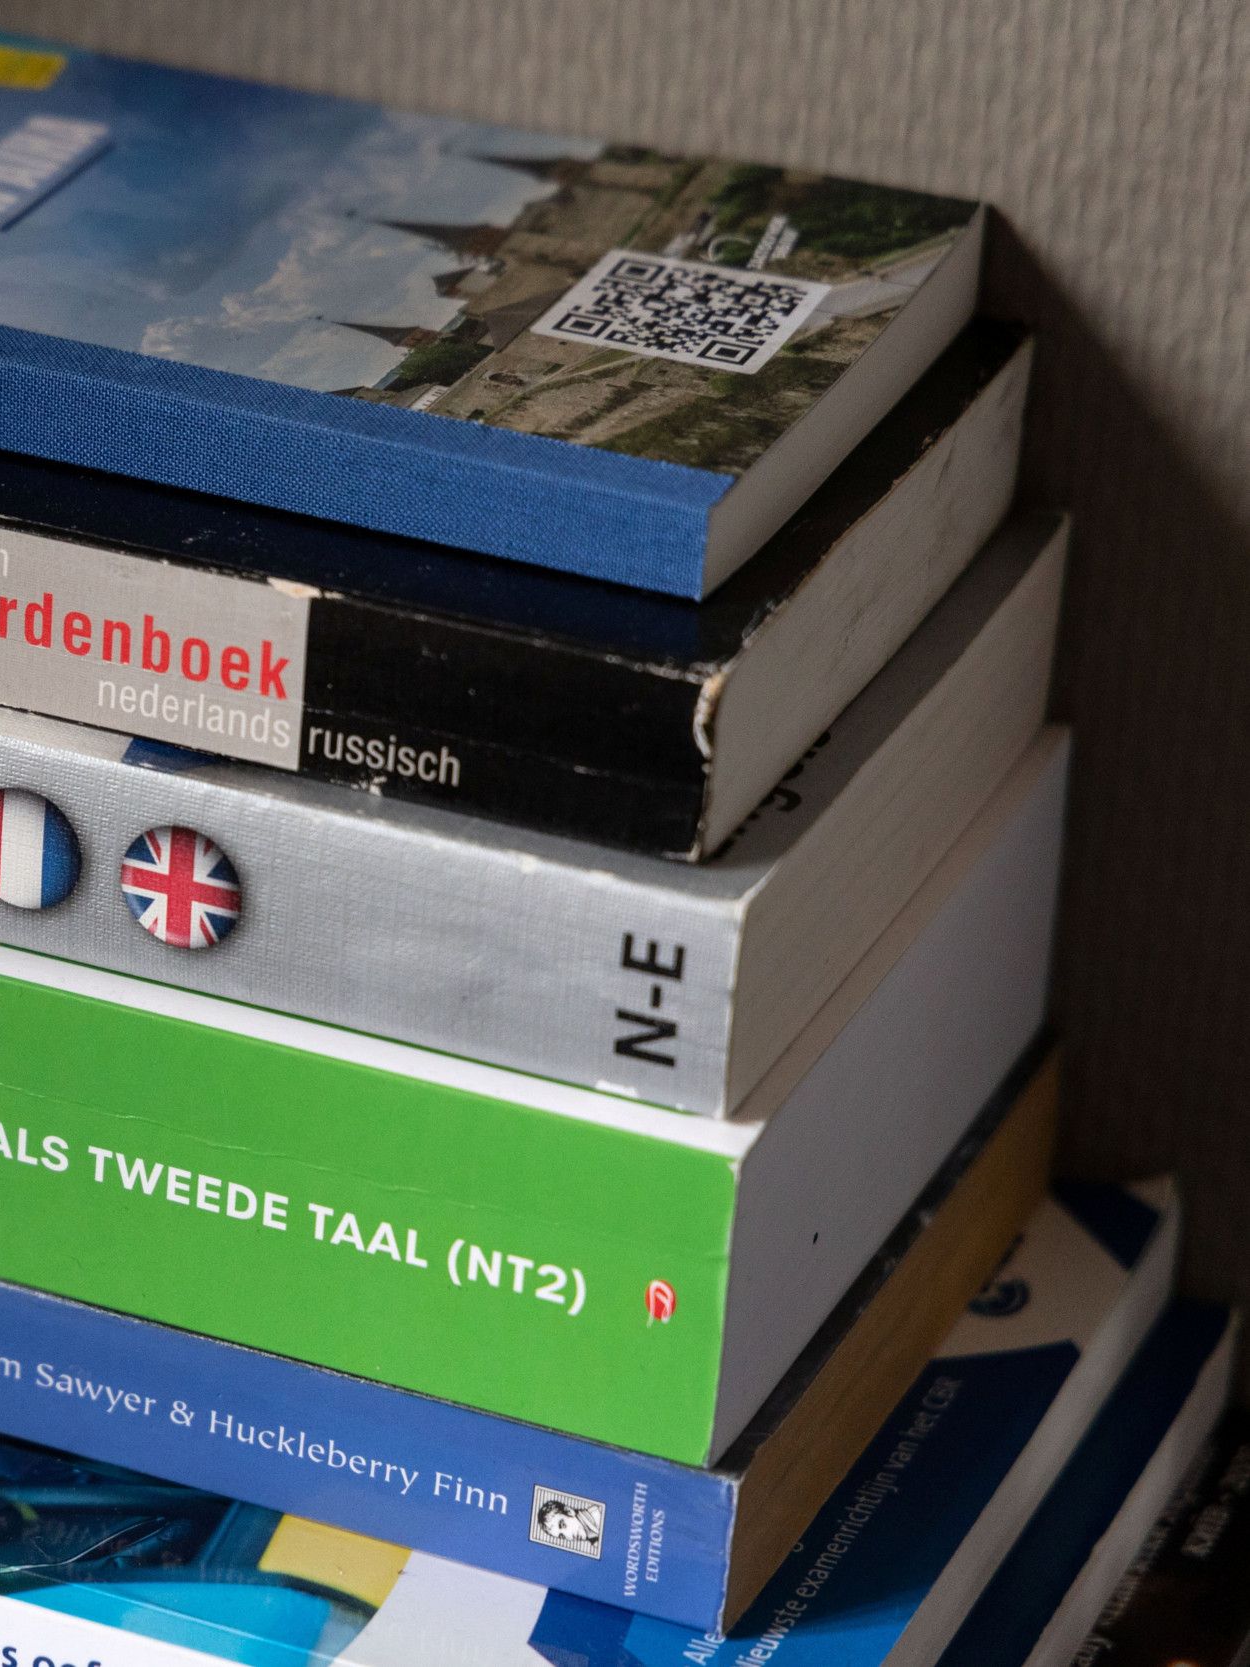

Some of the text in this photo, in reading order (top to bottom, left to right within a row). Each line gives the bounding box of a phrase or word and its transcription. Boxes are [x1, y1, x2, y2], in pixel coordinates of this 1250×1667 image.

[98, 676, 291, 749] nederlands
[308, 722, 462, 788] russisch
[613, 932, 685, 1068] N-E
[87, 1146, 290, 1231] TWEEDE
[308, 1203, 429, 1269] TAAL
[447, 1239, 587, 1316] (NT2)
[35, 1362, 157, 1418] Sawyer
[170, 1400, 195, 1427] &
[209, 1412, 419, 1496] Huckleberry
[434, 1472, 508, 1515] Finn
[624, 1482, 648, 1598] WORDSWORTH
[645, 1509, 665, 1583] EDITIONS
[796, 1470, 897, 1598] examenrichtlijn
[888, 1436, 916, 1470] van
